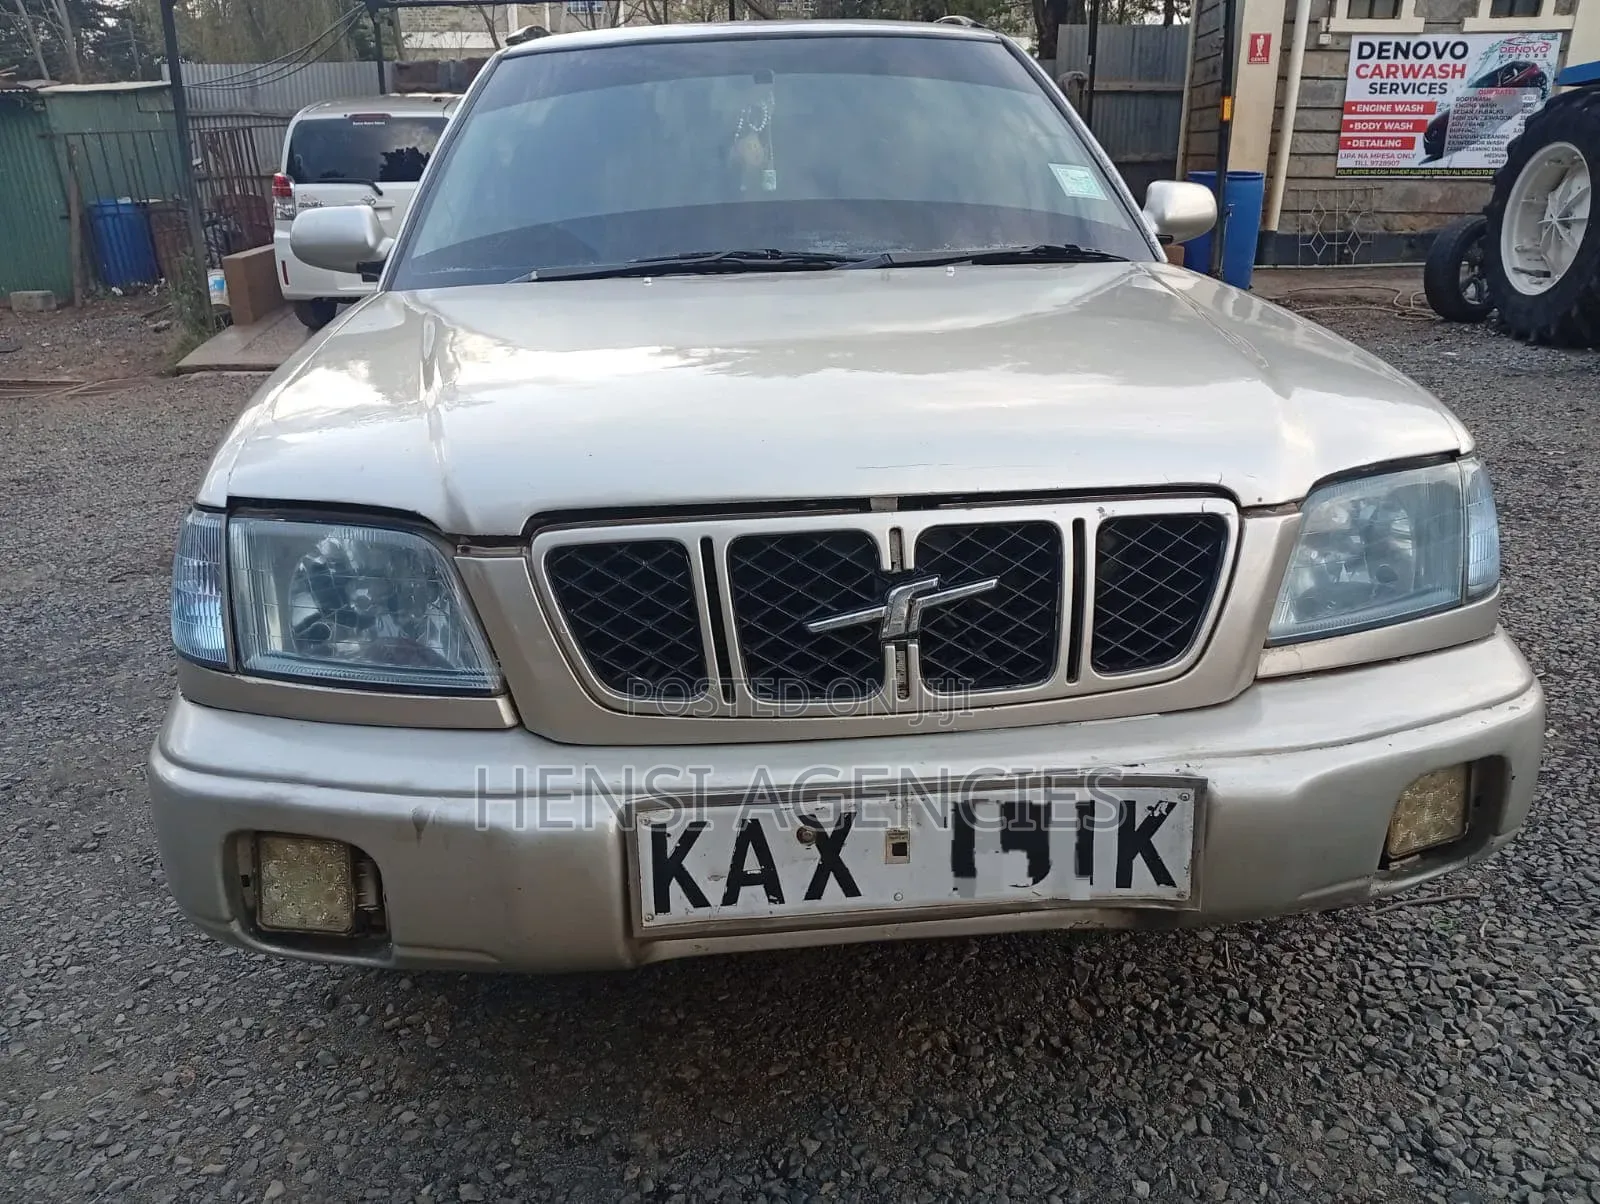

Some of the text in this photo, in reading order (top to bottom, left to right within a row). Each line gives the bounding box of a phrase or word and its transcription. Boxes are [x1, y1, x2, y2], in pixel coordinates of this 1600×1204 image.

[1357, 41, 1469, 60] DENOVO
[1500, 45, 1549, 53] DENOVO
[1355, 63, 1467, 79] CARWASH
[1368, 82, 1448, 95] SERVICES
[1357, 104, 1424, 112] ENGINE WASH
[1354, 122, 1414, 130] BODY WASH
[1352, 139, 1402, 147] DETAILING
[650, 811, 862, 916] KAX
